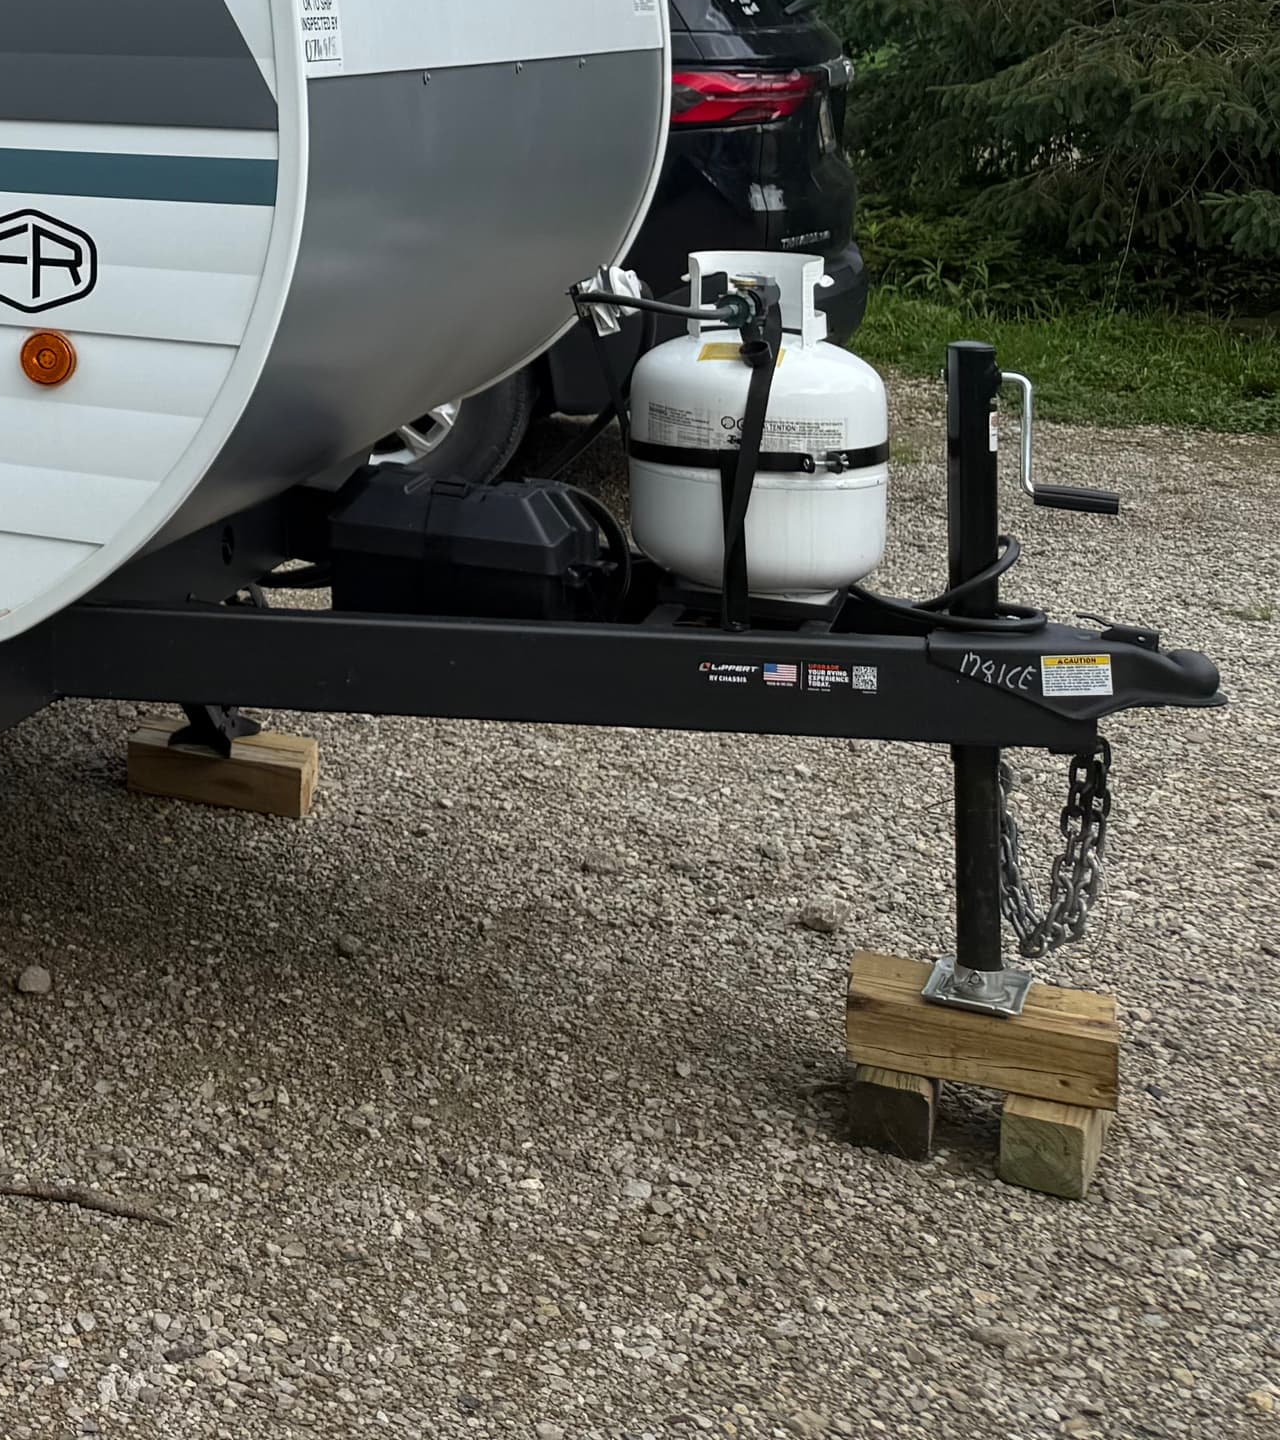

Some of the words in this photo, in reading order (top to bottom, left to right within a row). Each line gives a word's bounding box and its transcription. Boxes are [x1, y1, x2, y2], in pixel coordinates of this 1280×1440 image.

[711, 662, 759, 672] LIPPERT
[719, 675, 747, 683] CHASSIS
[808, 675, 849, 683] EXPERIENCE
